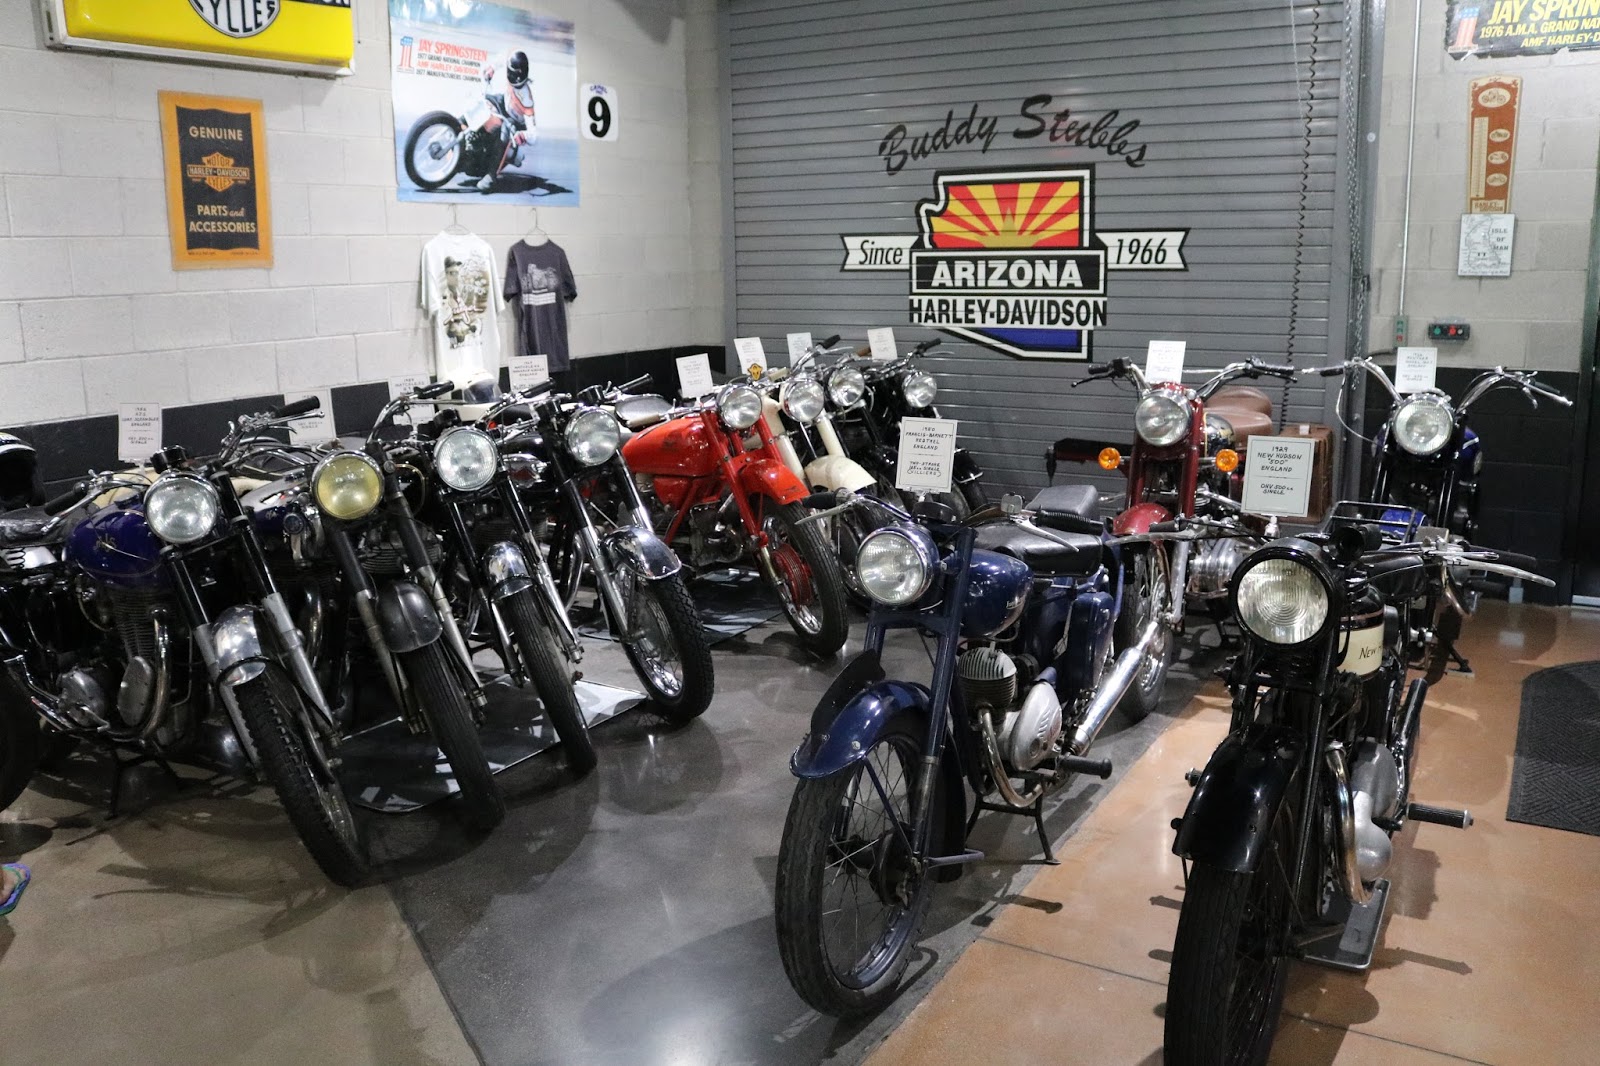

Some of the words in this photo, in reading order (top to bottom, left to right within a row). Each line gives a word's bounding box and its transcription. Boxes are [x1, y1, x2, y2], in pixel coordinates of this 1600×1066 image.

[1487, 0, 1526, 25] JAY
[1480, 25, 1504, 39] 1976
[1540, 19, 1579, 33] GRAND
[1581, 17, 1600, 30] NA
[418, 39, 433, 51] JAY
[434, 41, 489, 61] SPRINGSTEEN
[1520, 38, 1545, 48] AMF
[428, 53, 442, 61] GRAND
[443, 56, 461, 64] NATIONAL
[588, 96, 611, 138] 9
[189, 126, 244, 141] GENUINE
[879, 103, 998, 175] Buddy
[206, 154, 231, 166] MOTOR
[190, 166, 248, 177] HARLEY-DAVIDSON
[197, 205, 228, 217] PARTS
[229, 207, 246, 218] and
[189, 221, 256, 234] ACCESSORIES
[859, 240, 904, 265] Since
[1115, 238, 1168, 265] 1966
[931, 259, 1083, 289] ARIZONA
[909, 298, 1107, 327] HARLEY-DAVIDSON
[913, 443, 939, 451] ENGLAND
